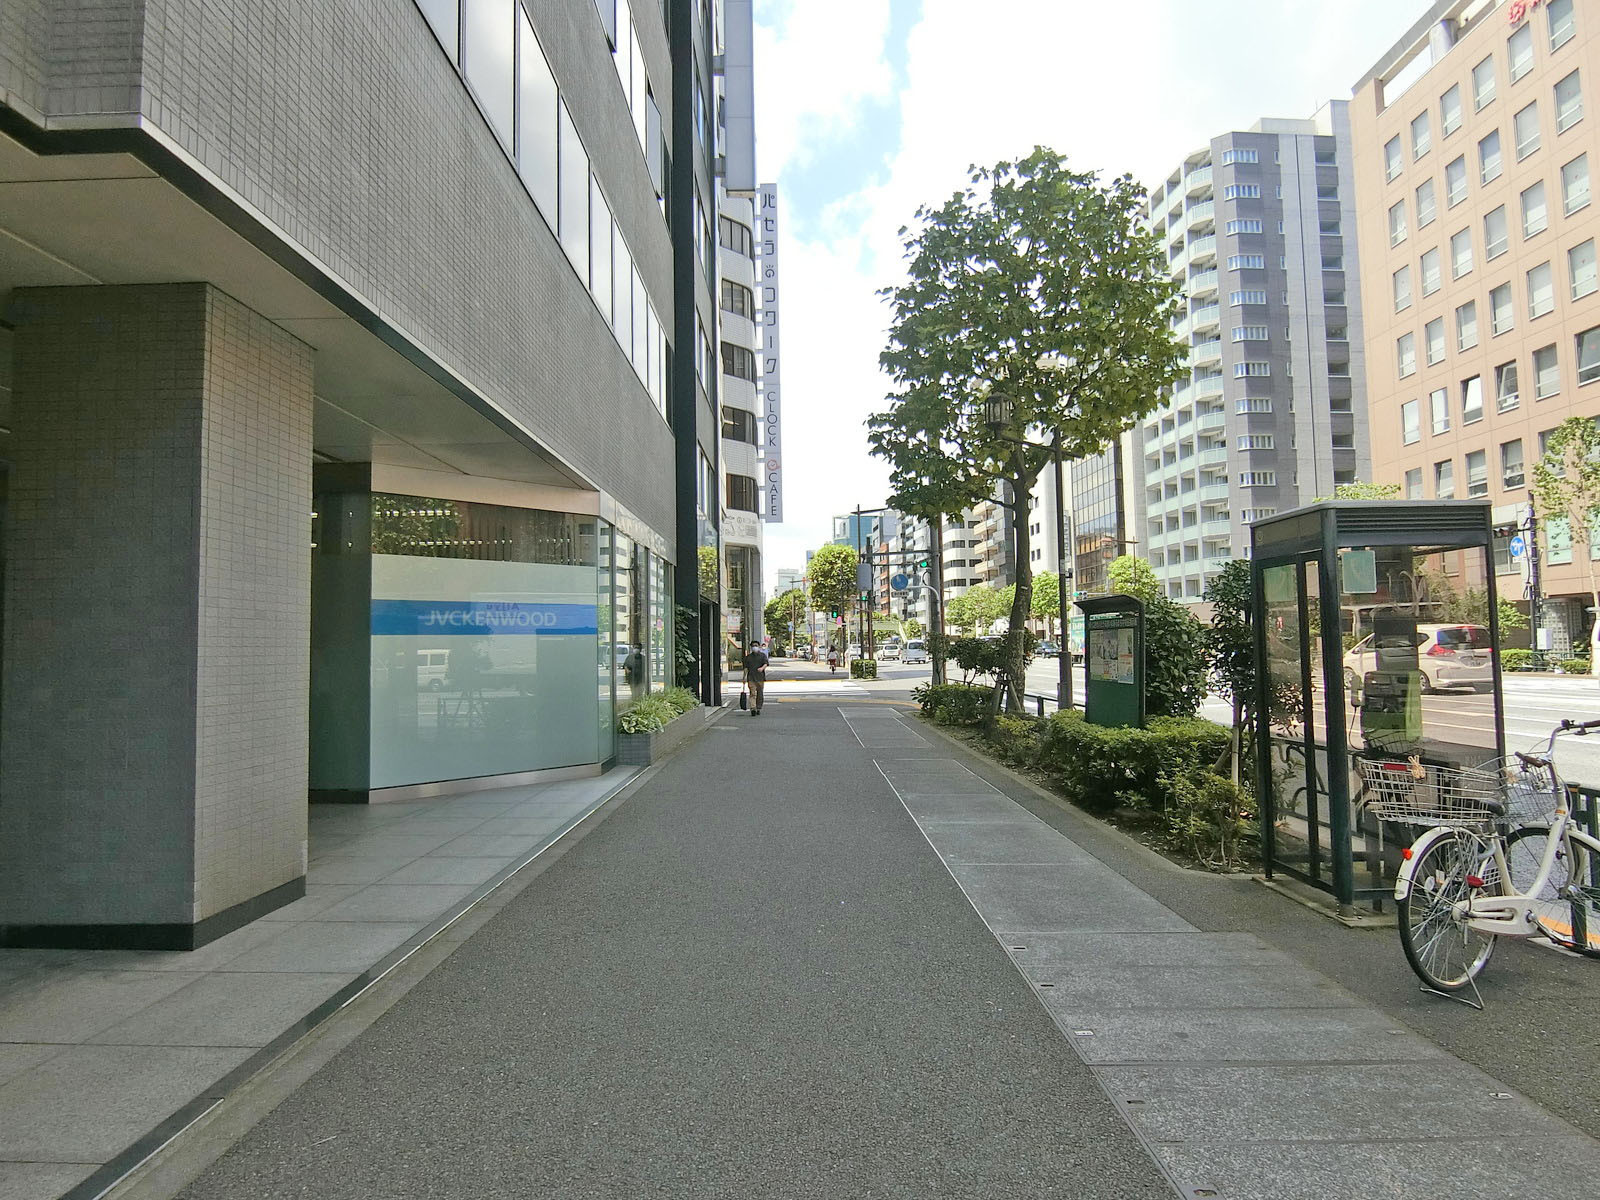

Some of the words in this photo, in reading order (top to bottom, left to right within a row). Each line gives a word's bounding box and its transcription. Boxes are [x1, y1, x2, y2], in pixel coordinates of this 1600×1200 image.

[766, 391, 778, 447] CLOCK
[768, 473, 779, 516] CAFE
[424, 610, 557, 626] JVCKENWOOD
